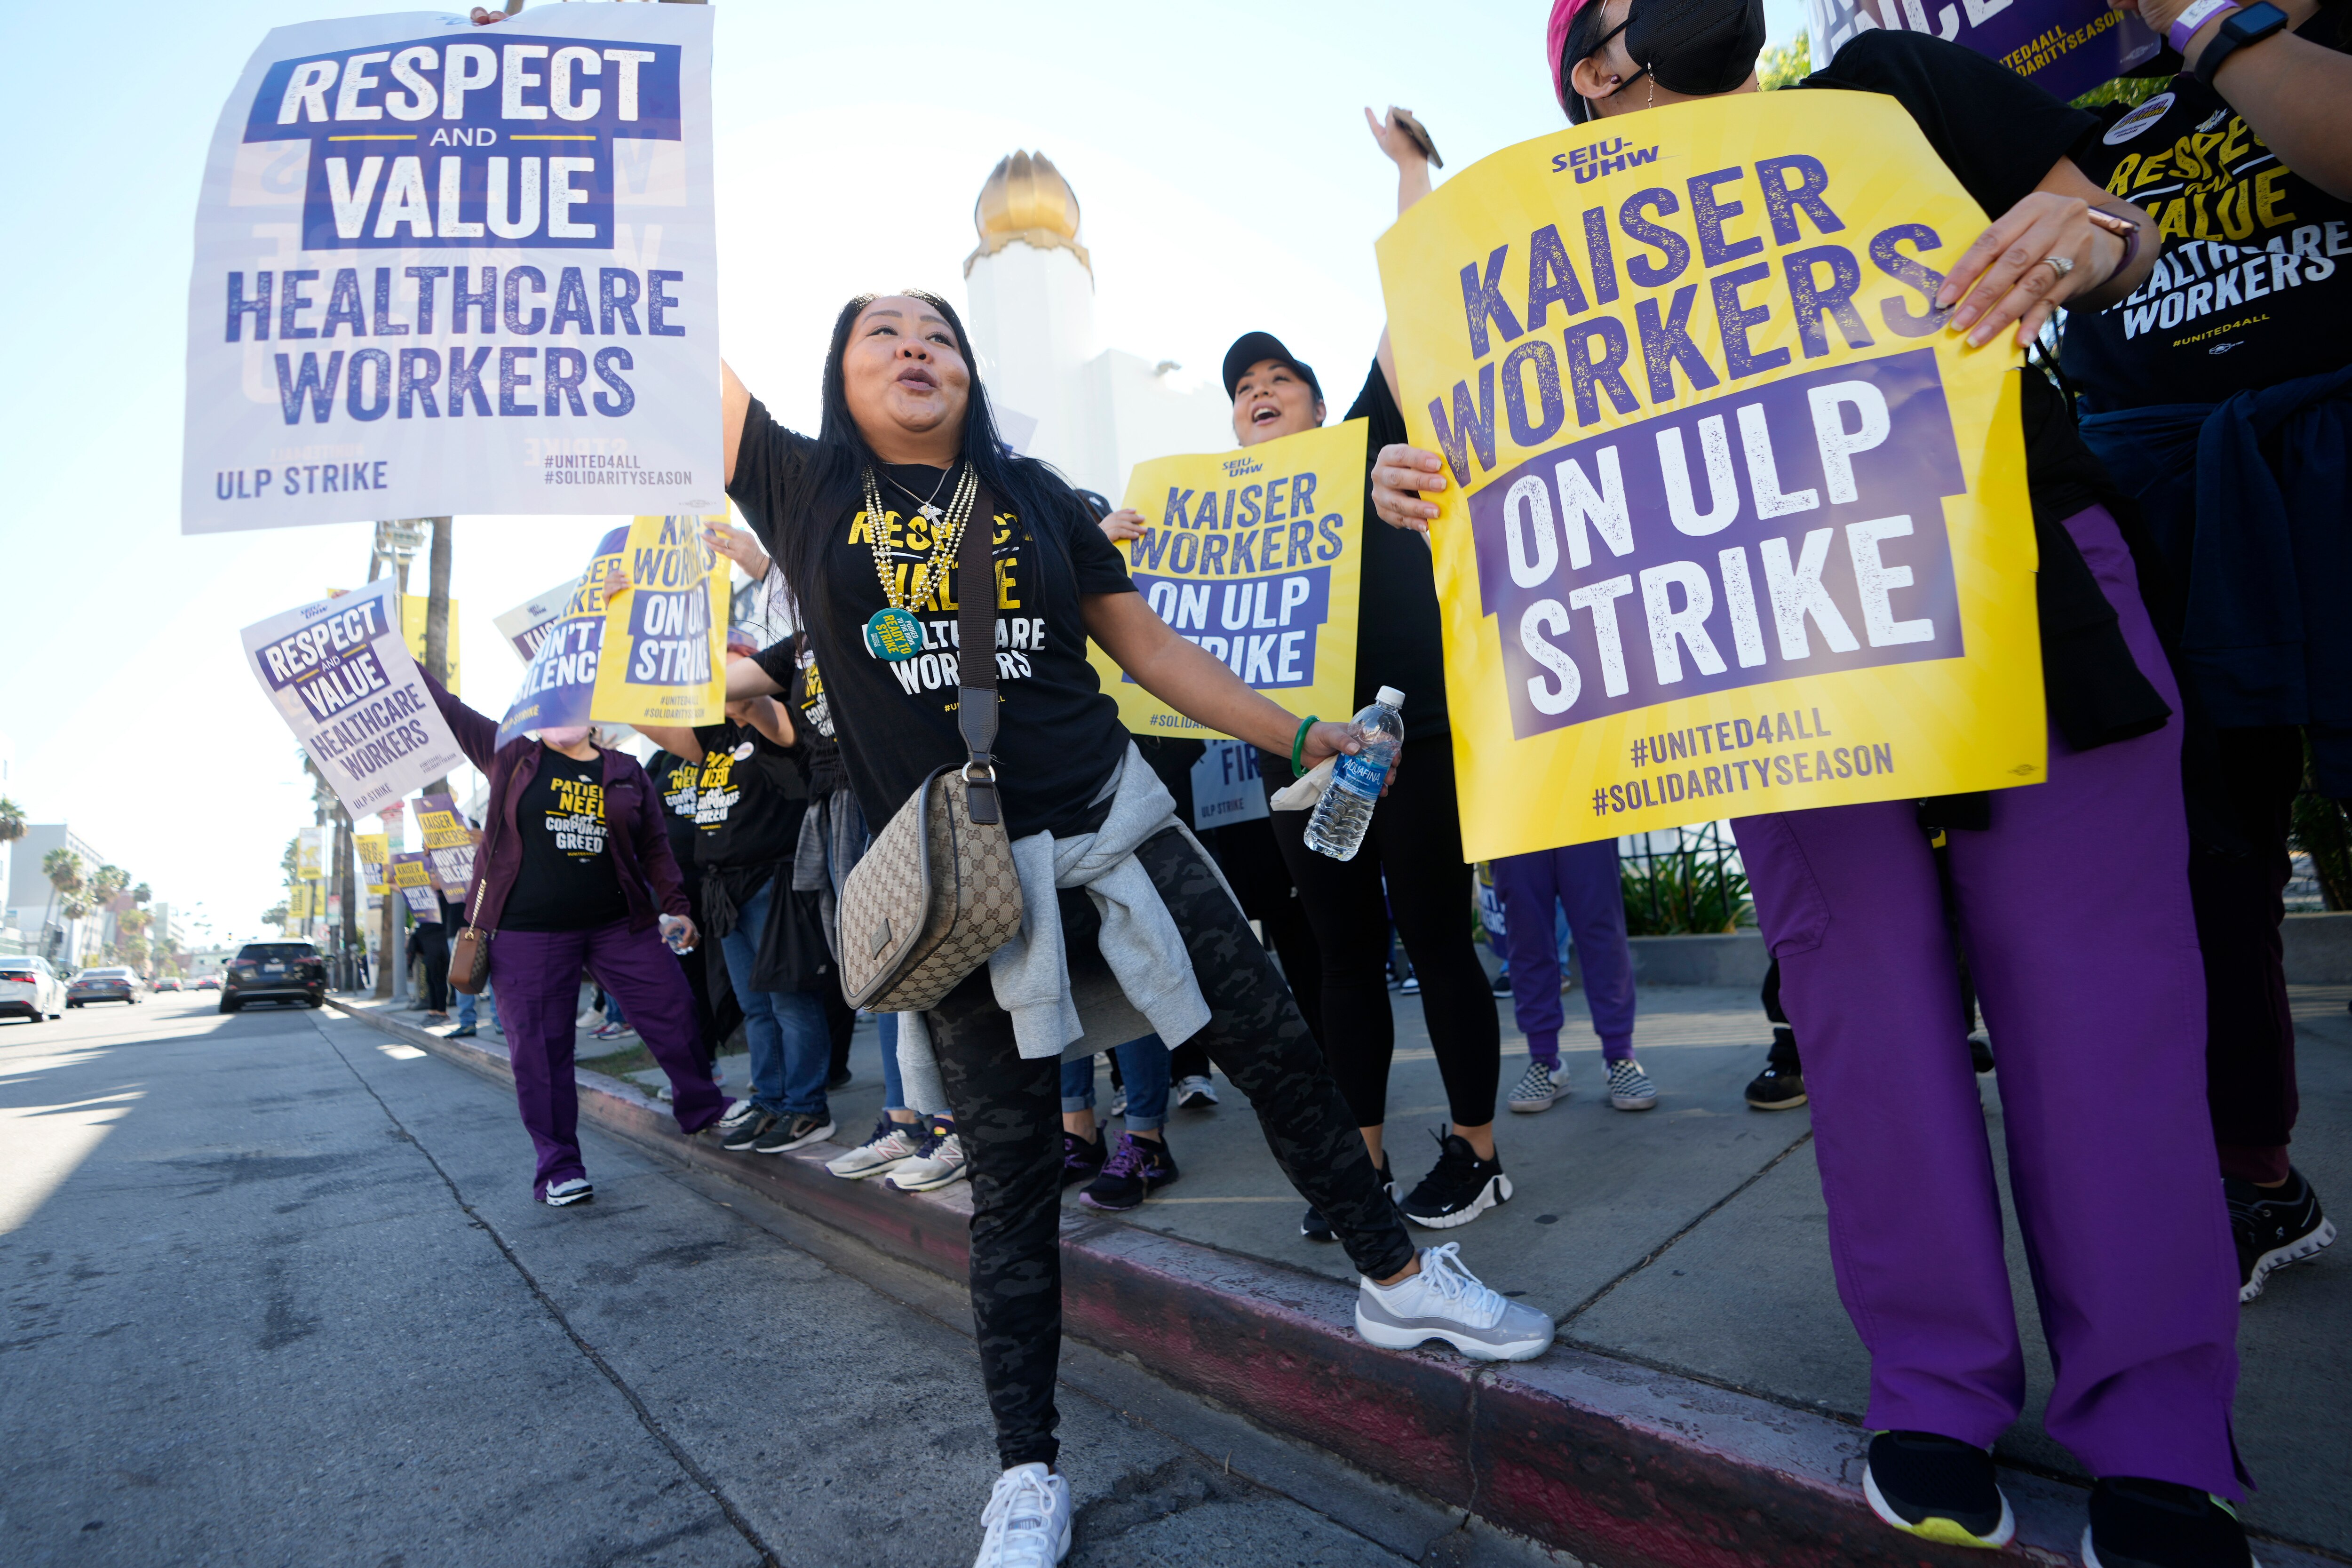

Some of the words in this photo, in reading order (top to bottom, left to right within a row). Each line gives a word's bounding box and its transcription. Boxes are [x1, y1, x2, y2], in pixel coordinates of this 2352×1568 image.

[277, 45, 655, 125] RESPECT
[429, 127, 496, 148] AND
[1552, 137, 1632, 173] SEIU-
[2105, 115, 2266, 196] RESPE
[1574, 145, 1659, 184] UHW
[2185, 160, 2232, 197] and
[325, 156, 596, 239] VALUE
[1459, 154, 1845, 359] KAISER
[225, 265, 685, 343] HEALTHCARE
[2123, 253, 2336, 340] WORKERS
[2172, 314, 2270, 348] #UNITED4ALL
[1428, 223, 1952, 488] WORKERS
[274, 345, 636, 425] WORKERS
[216, 469, 273, 501] ULP
[284, 461, 389, 496] STRIKE
[544, 454, 641, 470] #UNITED4ALL
[544, 470, 692, 486] #SOLIDARITYSEASON
[1230, 463, 1263, 477] UHW
[1163, 472, 1316, 530] KAISER
[1503, 444, 1634, 589] ON
[1655, 379, 1891, 537] ULP
[1131, 512, 1343, 575] WORKERS
[875, 557, 1020, 612] VALE
[1147, 581, 1211, 629] ON
[1224, 575, 1311, 631] ULP
[644, 594, 685, 636] ON
[883, 614, 906, 641] READY
[898, 642, 912, 654] TO
[900, 623, 908, 633] THE
[904, 632, 916, 646] BRINK
[905, 620, 919, 639] PUSHED
[1520, 514, 1935, 716] STRIKE
[265, 601, 376, 683] RESPECT
[635, 638, 710, 682] STRIKE
[875, 624, 899, 654] STRIKE
[301, 652, 385, 717] VALUE
[322, 655, 341, 671] AND
[310, 683, 427, 762] HEALTHCARE
[1629, 707, 1831, 769] #UNITED4ALL
[339, 719, 429, 781] WORKERS
[1343, 758, 1379, 784] AQUAFINA
[353, 795, 367, 809] ULP
[368, 783, 392, 802] STRIKE
[1592, 742, 1894, 818] #SOLIDARITYSEASON
[421, 815, 453, 830] KAISER
[545, 817, 609, 837] CORPORAT
[1201, 805, 1216, 818] ULP
[1218, 798, 1244, 814] STRIKE
[556, 832, 603, 853] GREED
